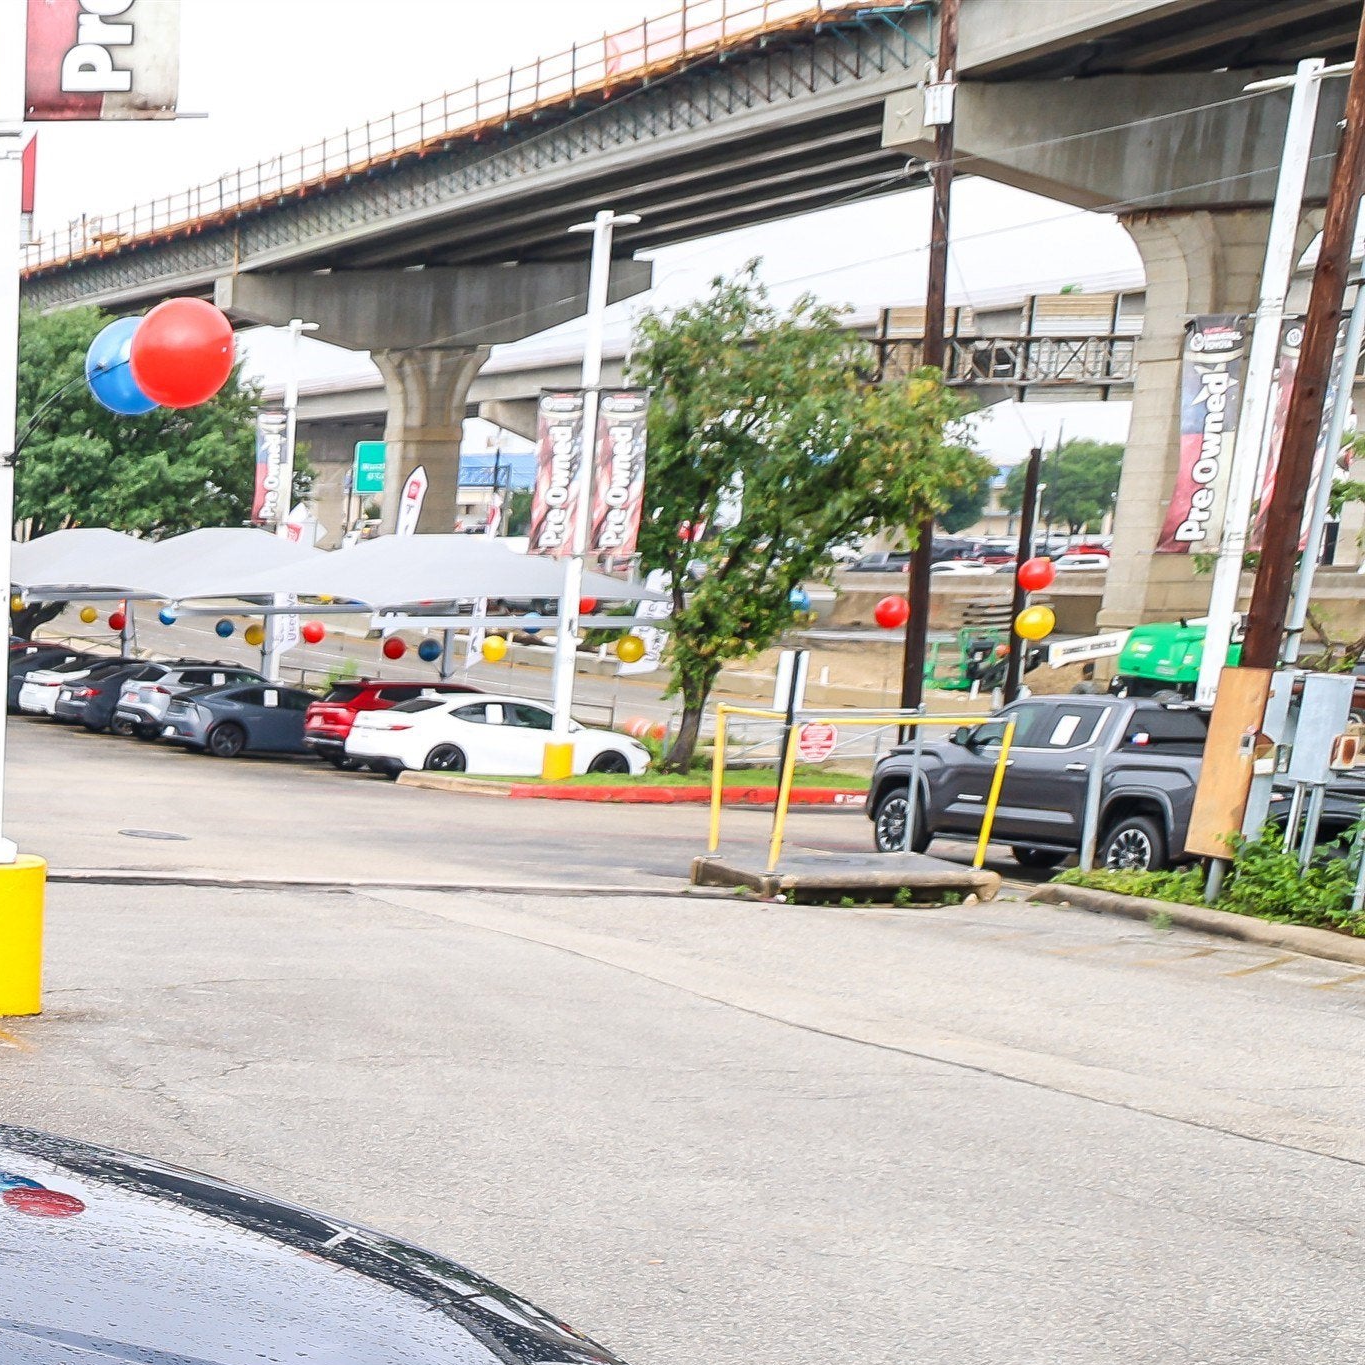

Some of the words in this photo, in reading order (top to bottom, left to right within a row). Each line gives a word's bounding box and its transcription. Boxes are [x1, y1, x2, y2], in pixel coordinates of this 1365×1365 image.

[1191, 371, 1231, 485] Owned
[544, 425, 573, 507] Owned
[604, 425, 634, 507] Owned
[258, 491, 279, 519] Pre
[537, 508, 567, 549] Pre
[598, 508, 628, 549] Pre
[1174, 487, 1214, 542] Pre
